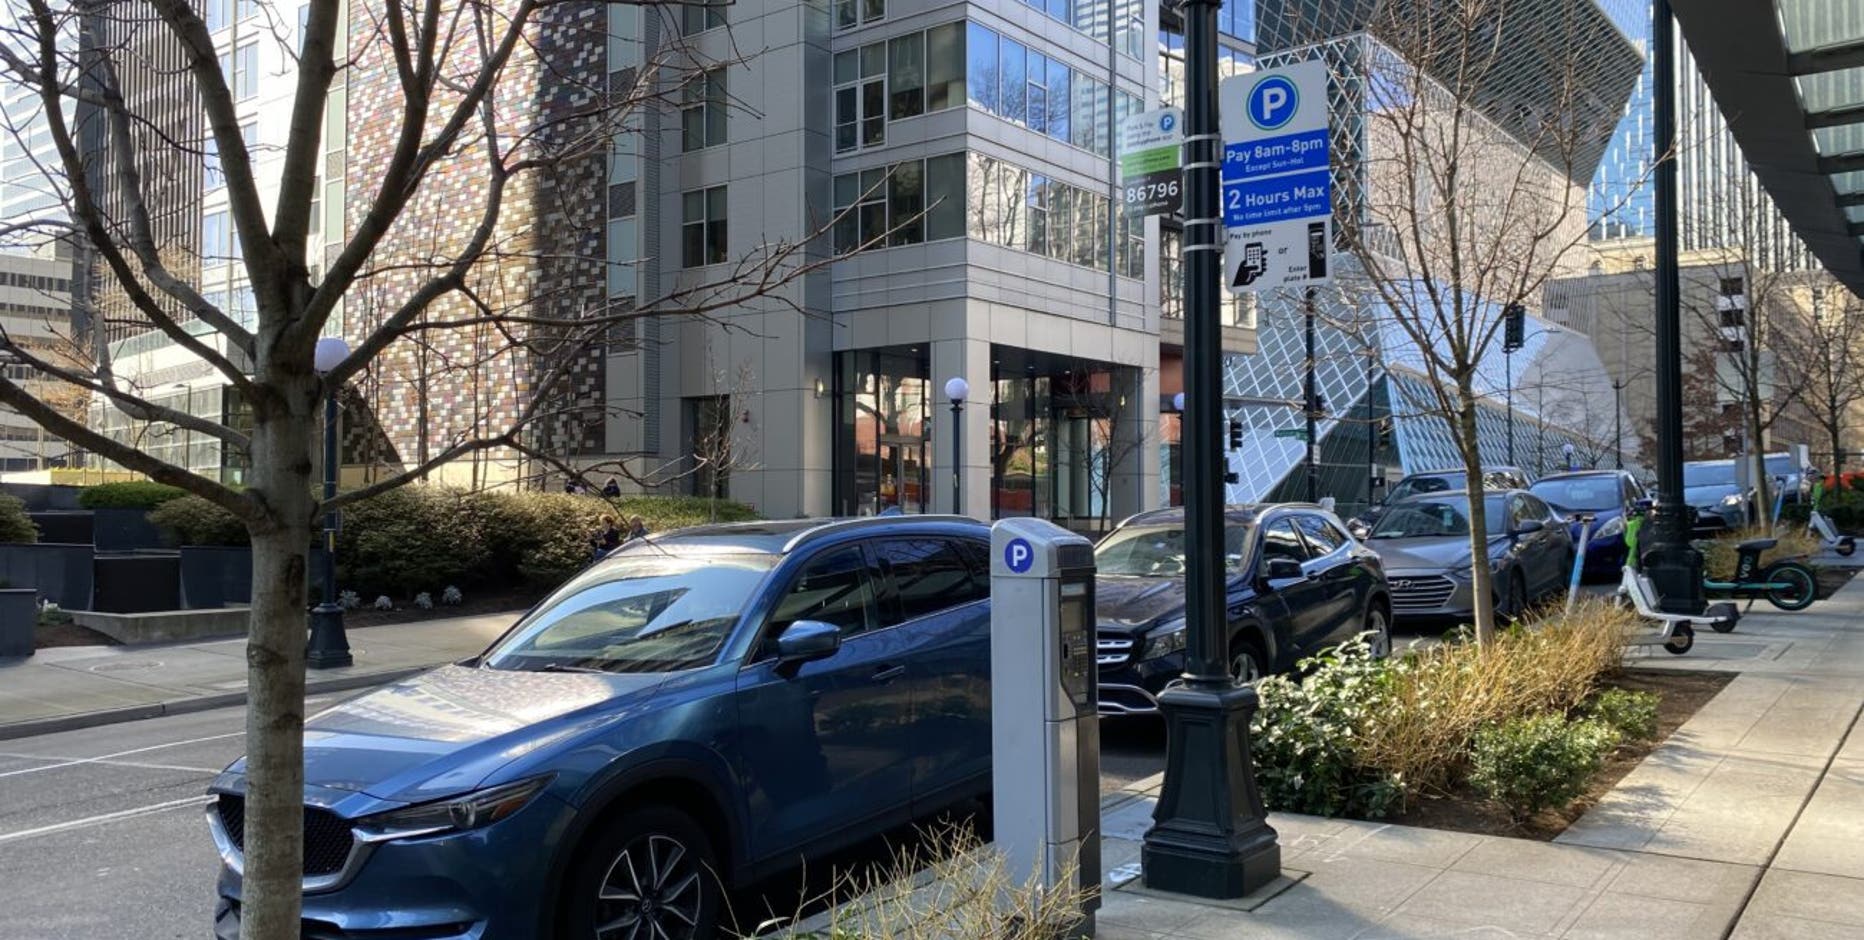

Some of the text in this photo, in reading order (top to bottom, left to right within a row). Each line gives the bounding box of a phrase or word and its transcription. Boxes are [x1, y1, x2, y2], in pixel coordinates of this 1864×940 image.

[1263, 86, 1287, 120] P
[1163, 116, 1172, 129] P
[1226, 138, 1323, 164] Pay 8am-8pm
[1245, 162, 1271, 173] Except
[1127, 181, 1178, 203] 86796
[1229, 186, 1325, 210] 2 Hours Max
[1245, 211, 1262, 219] time
[1283, 205, 1301, 214] after
[1243, 231, 1250, 239] by
[1252, 229, 1272, 238] phone
[1278, 247, 1288, 255] or
[1288, 265, 1307, 273] Enter
[1283, 275, 1300, 283] plate
[1012, 545, 1027, 567] P
